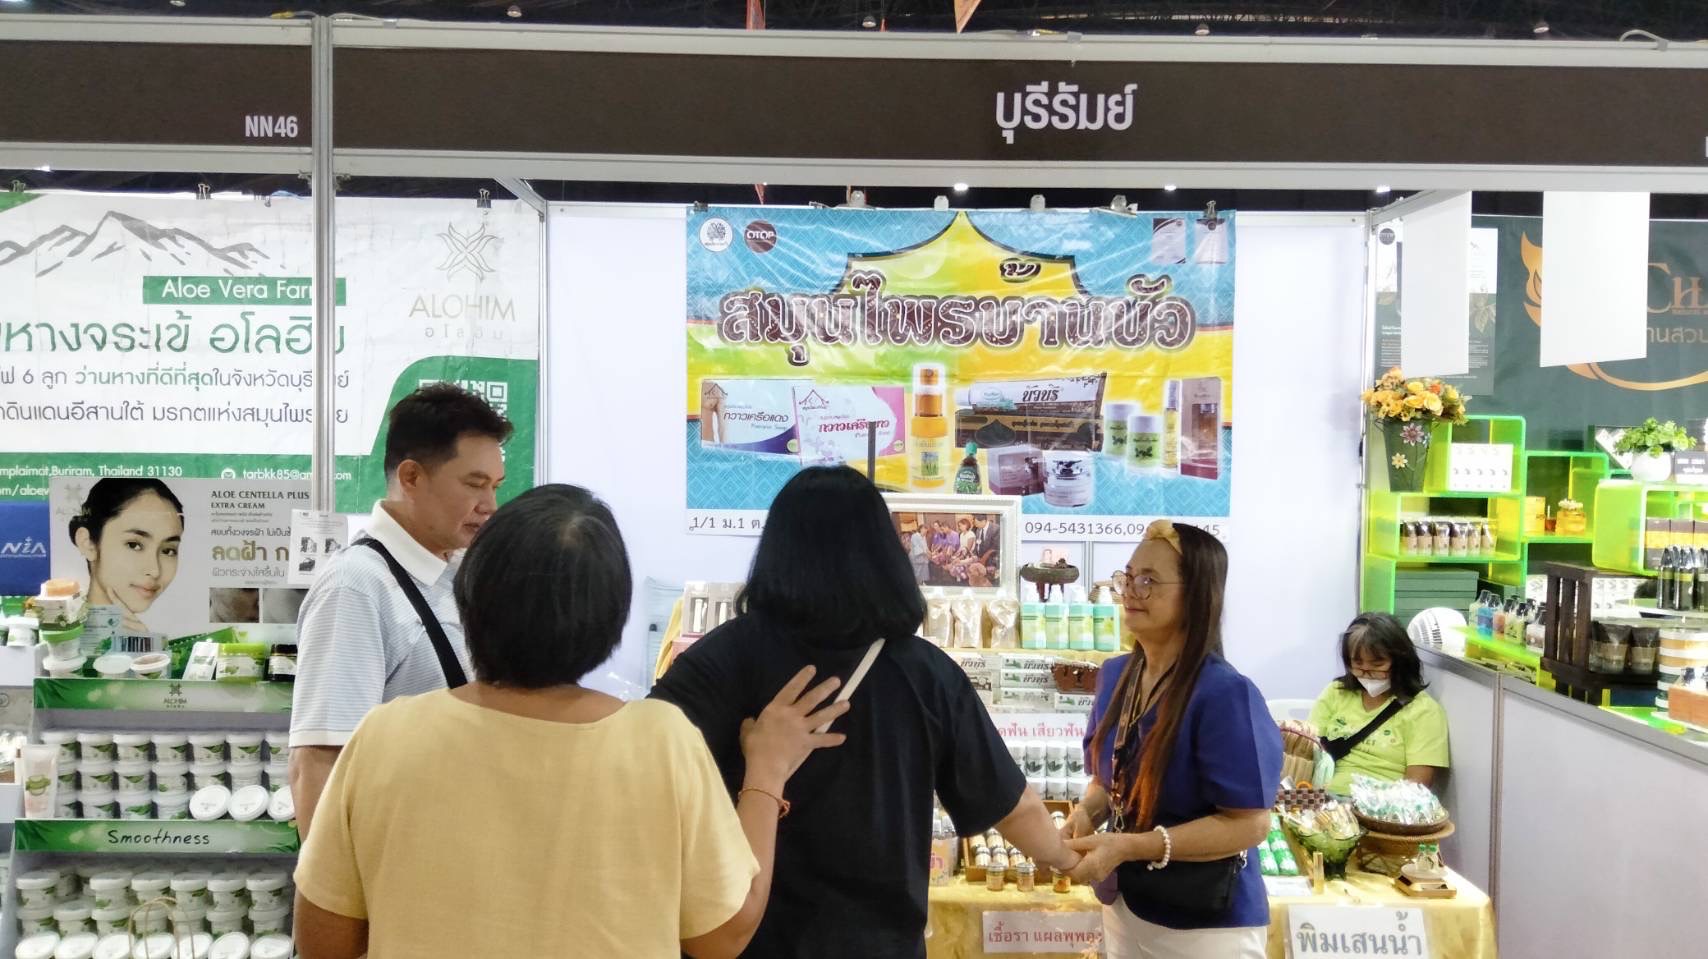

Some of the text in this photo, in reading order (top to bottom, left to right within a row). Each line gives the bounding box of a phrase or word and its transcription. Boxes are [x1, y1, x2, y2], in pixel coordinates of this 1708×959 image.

[996, 81, 1138, 144] บุรีรัมย์
[245, 115, 298, 137] NN46
[746, 230, 775, 240] OTOP
[162, 276, 312, 299] Aloe Vera Far
[408, 294, 516, 322] ALOHIM
[0, 310, 192, 352] หางจระเข้
[23, 368, 34, 384] 6
[42, 371, 67, 390] ลูก
[99, 465, 143, 477] Thailand
[147, 467, 183, 477] 31130
[211, 490, 310, 500] ALOE CENTELLA PLUS
[693, 517, 716, 528] 1/1
[722, 518, 744, 529] ม.1
[212, 540, 267, 561] ลดฝ้า
[107, 829, 210, 845] Smoothness
[988, 920, 1029, 942] เชื้อรา
[1296, 910, 1422, 956] พิมเสนน้ำ
